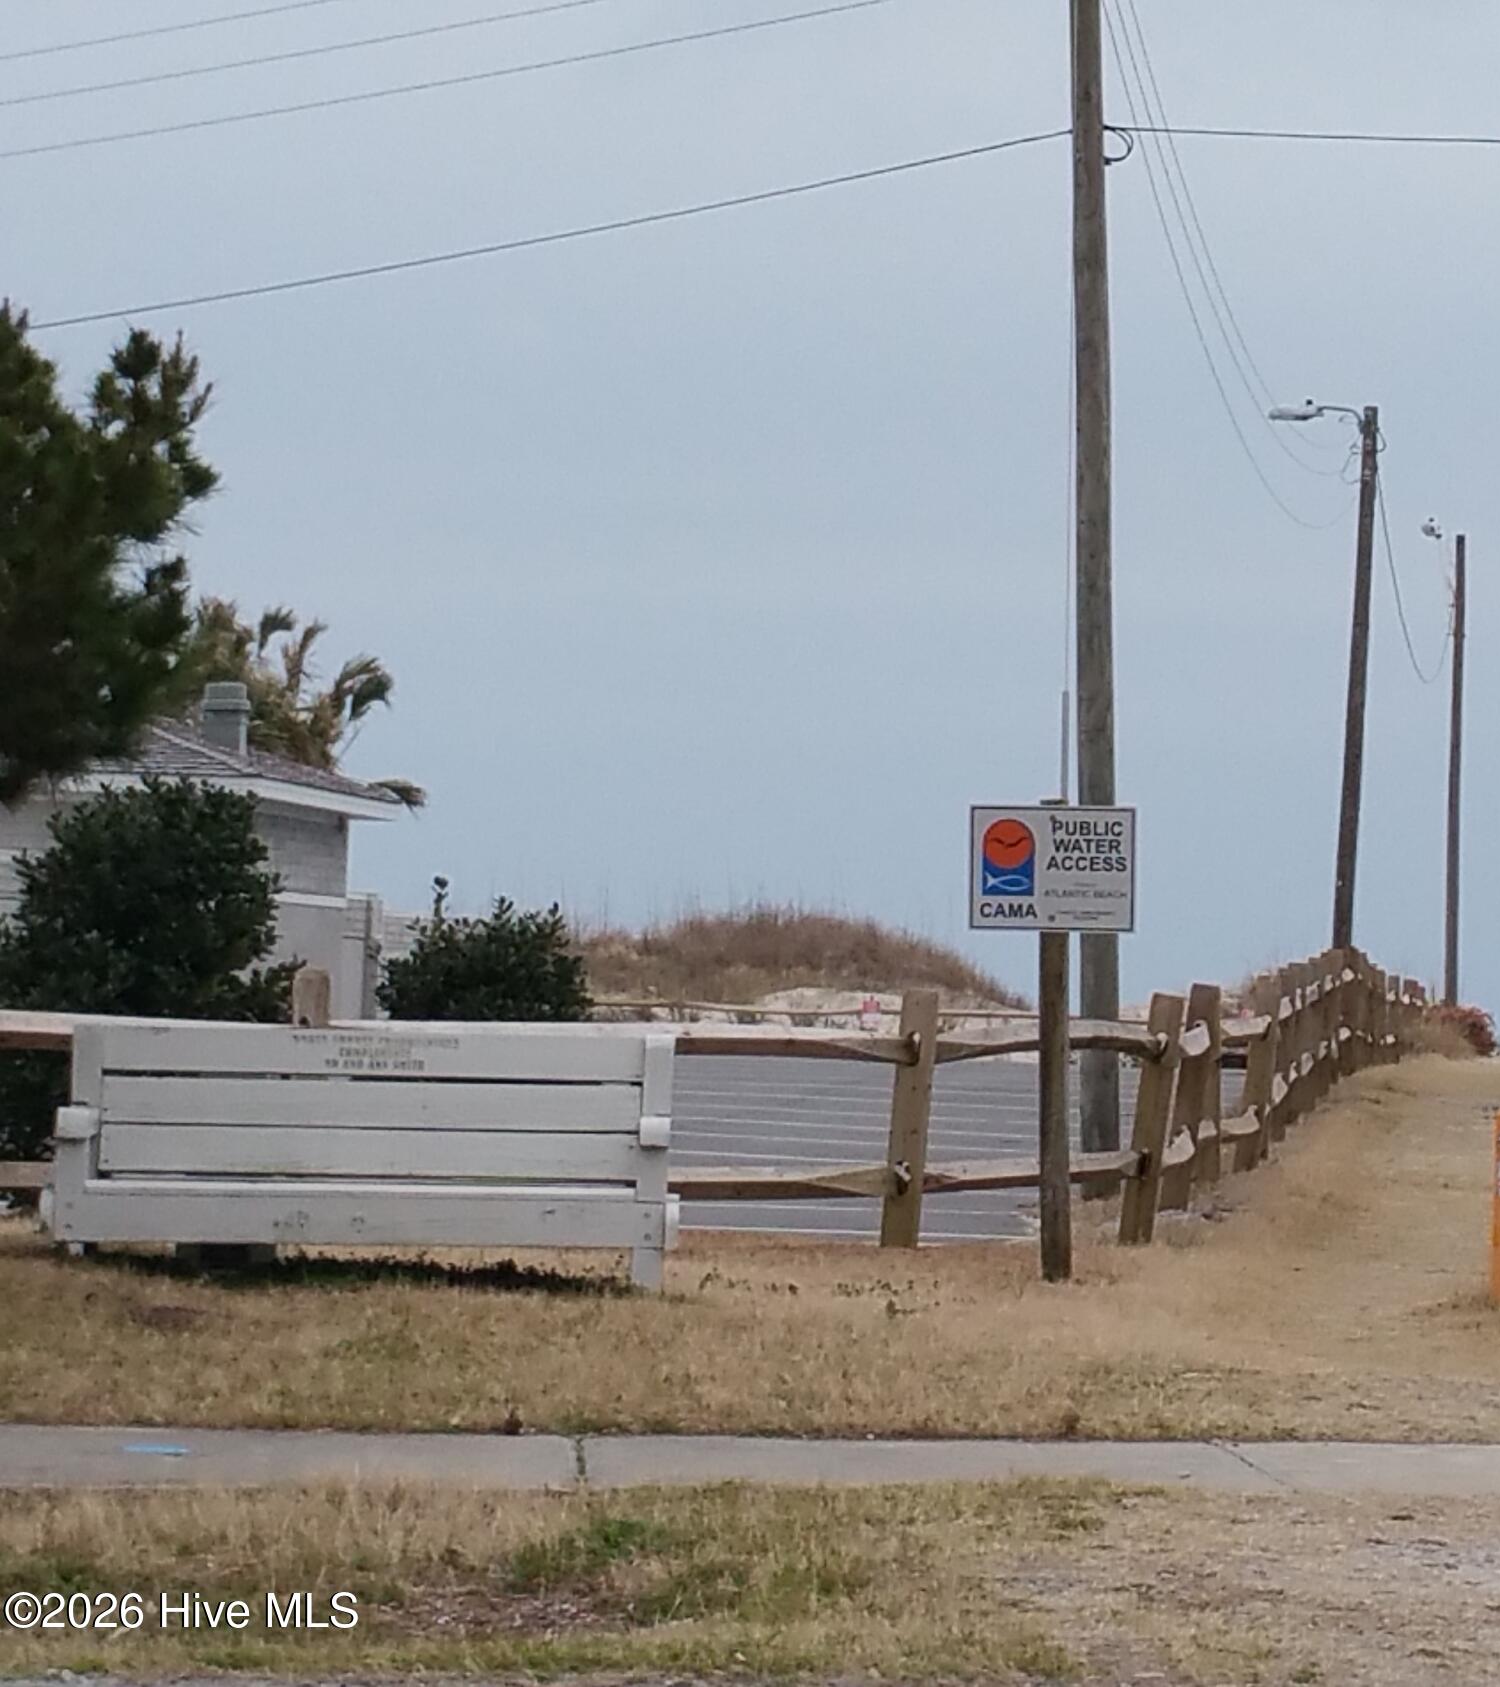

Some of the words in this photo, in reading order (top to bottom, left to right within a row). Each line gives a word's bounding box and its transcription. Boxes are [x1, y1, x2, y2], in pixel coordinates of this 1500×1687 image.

[1052, 820, 1124, 837] PUBLIC
[1053, 838, 1122, 854] WATER
[1046, 855, 1127, 872] ACCESS
[1044, 889, 1090, 898] ATLANTIC
[1093, 890, 1127, 898] BEACH
[980, 902, 1038, 919] CAMA
